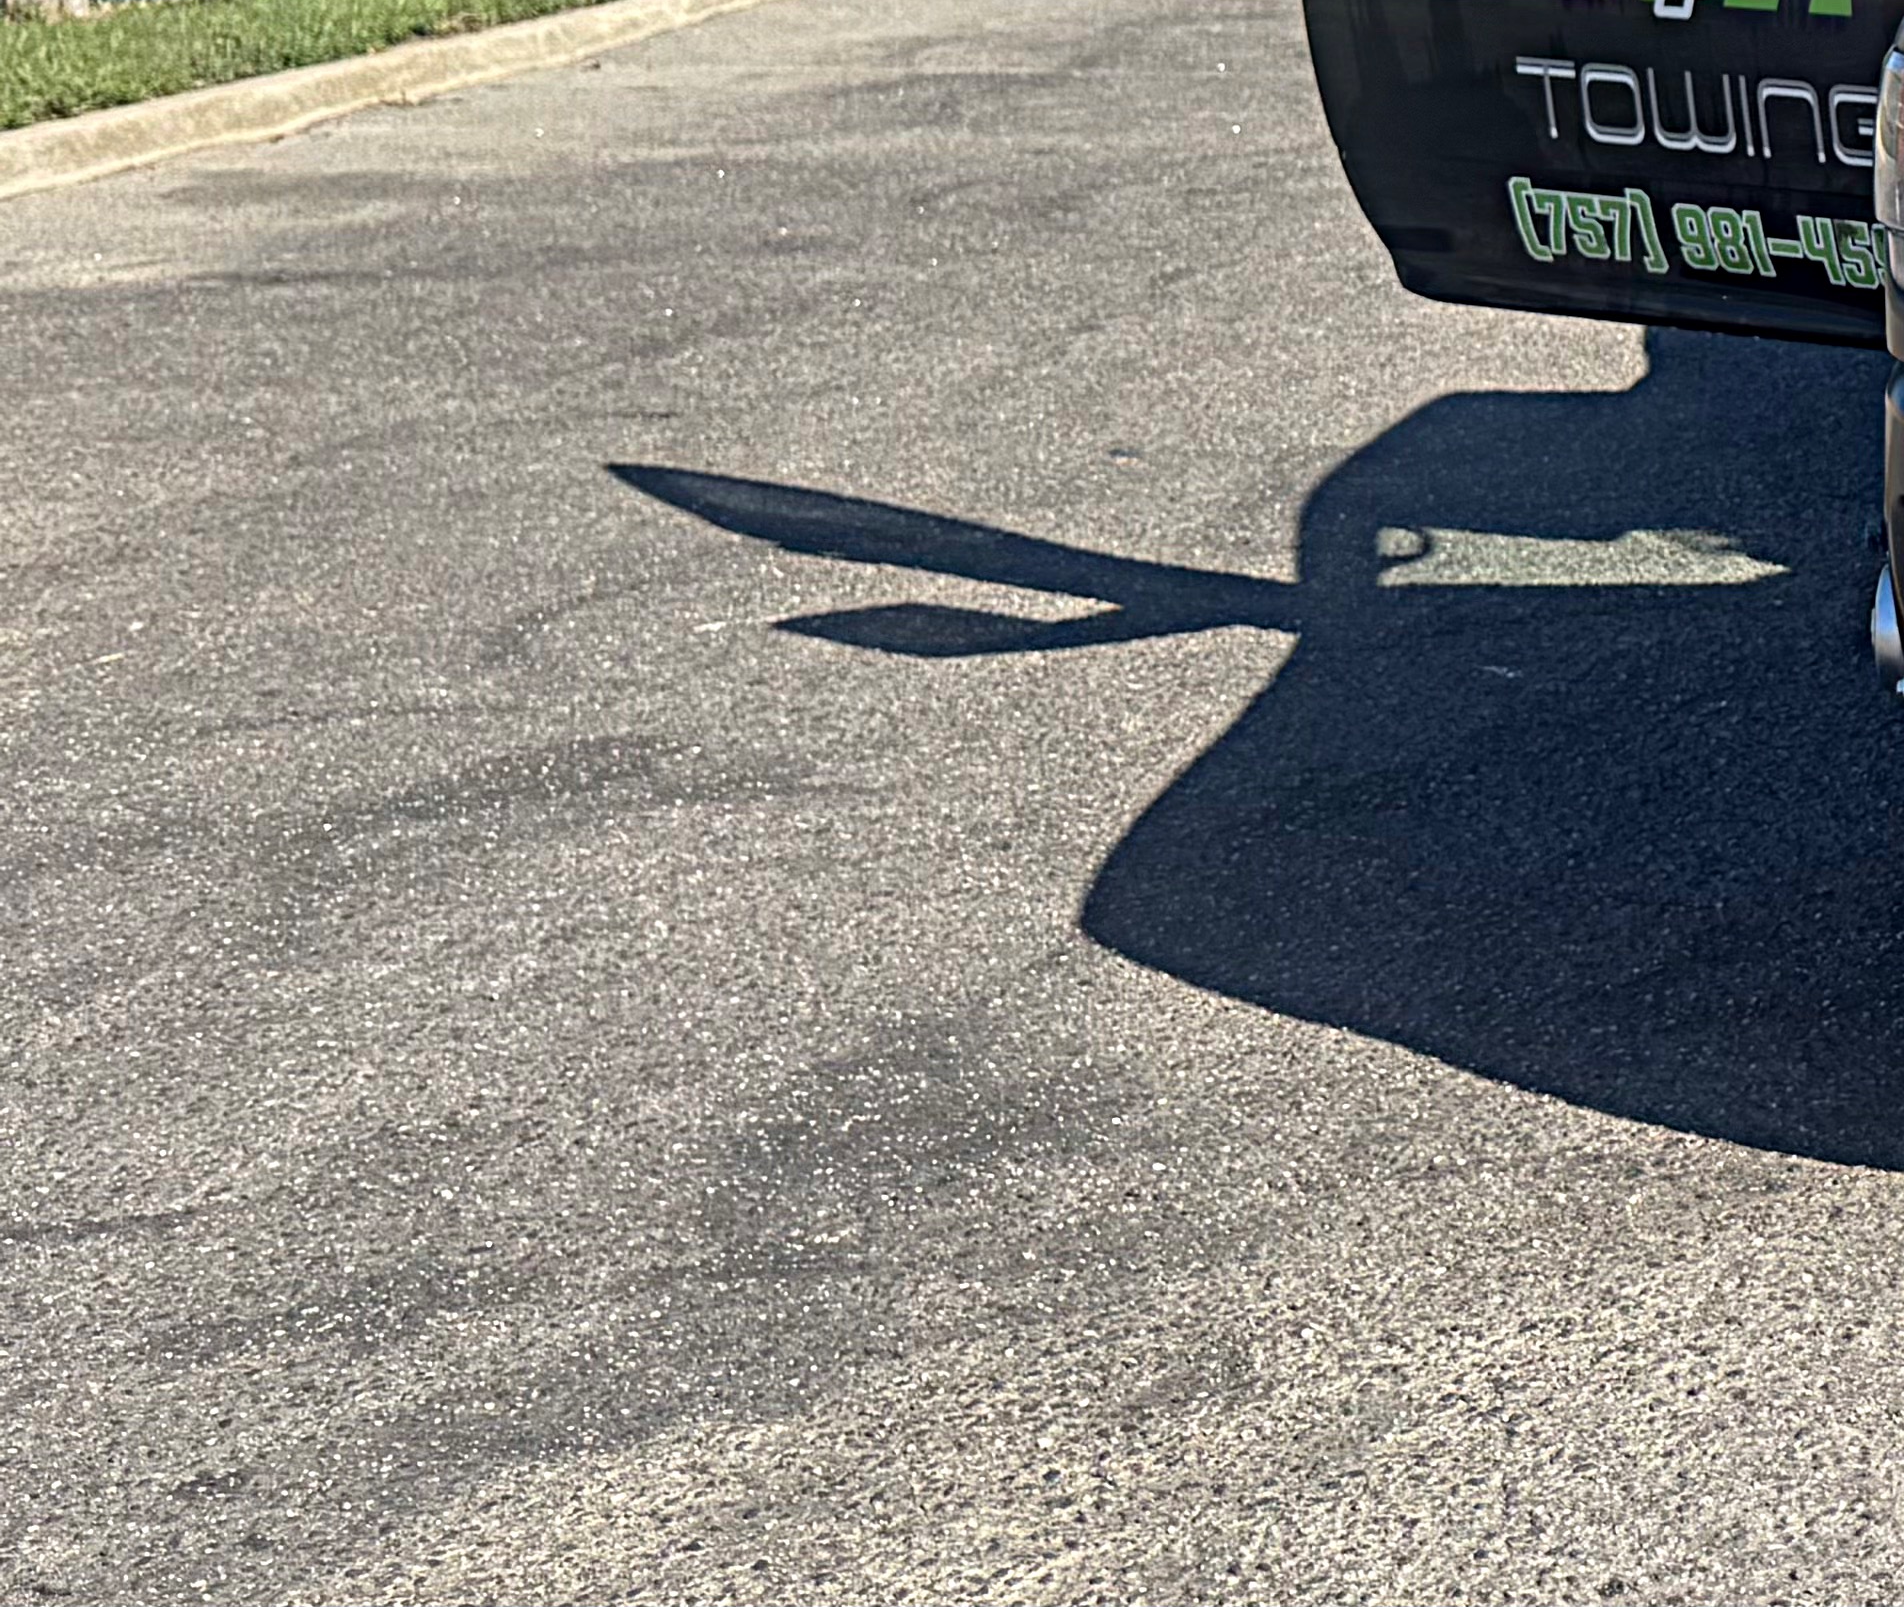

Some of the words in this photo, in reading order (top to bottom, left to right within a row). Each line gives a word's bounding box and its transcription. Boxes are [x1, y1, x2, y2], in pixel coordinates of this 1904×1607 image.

[1515, 55, 1878, 167] TOWING
[1508, 177, 1669, 273] (757)
[1672, 202, 1886, 289] 981-45
